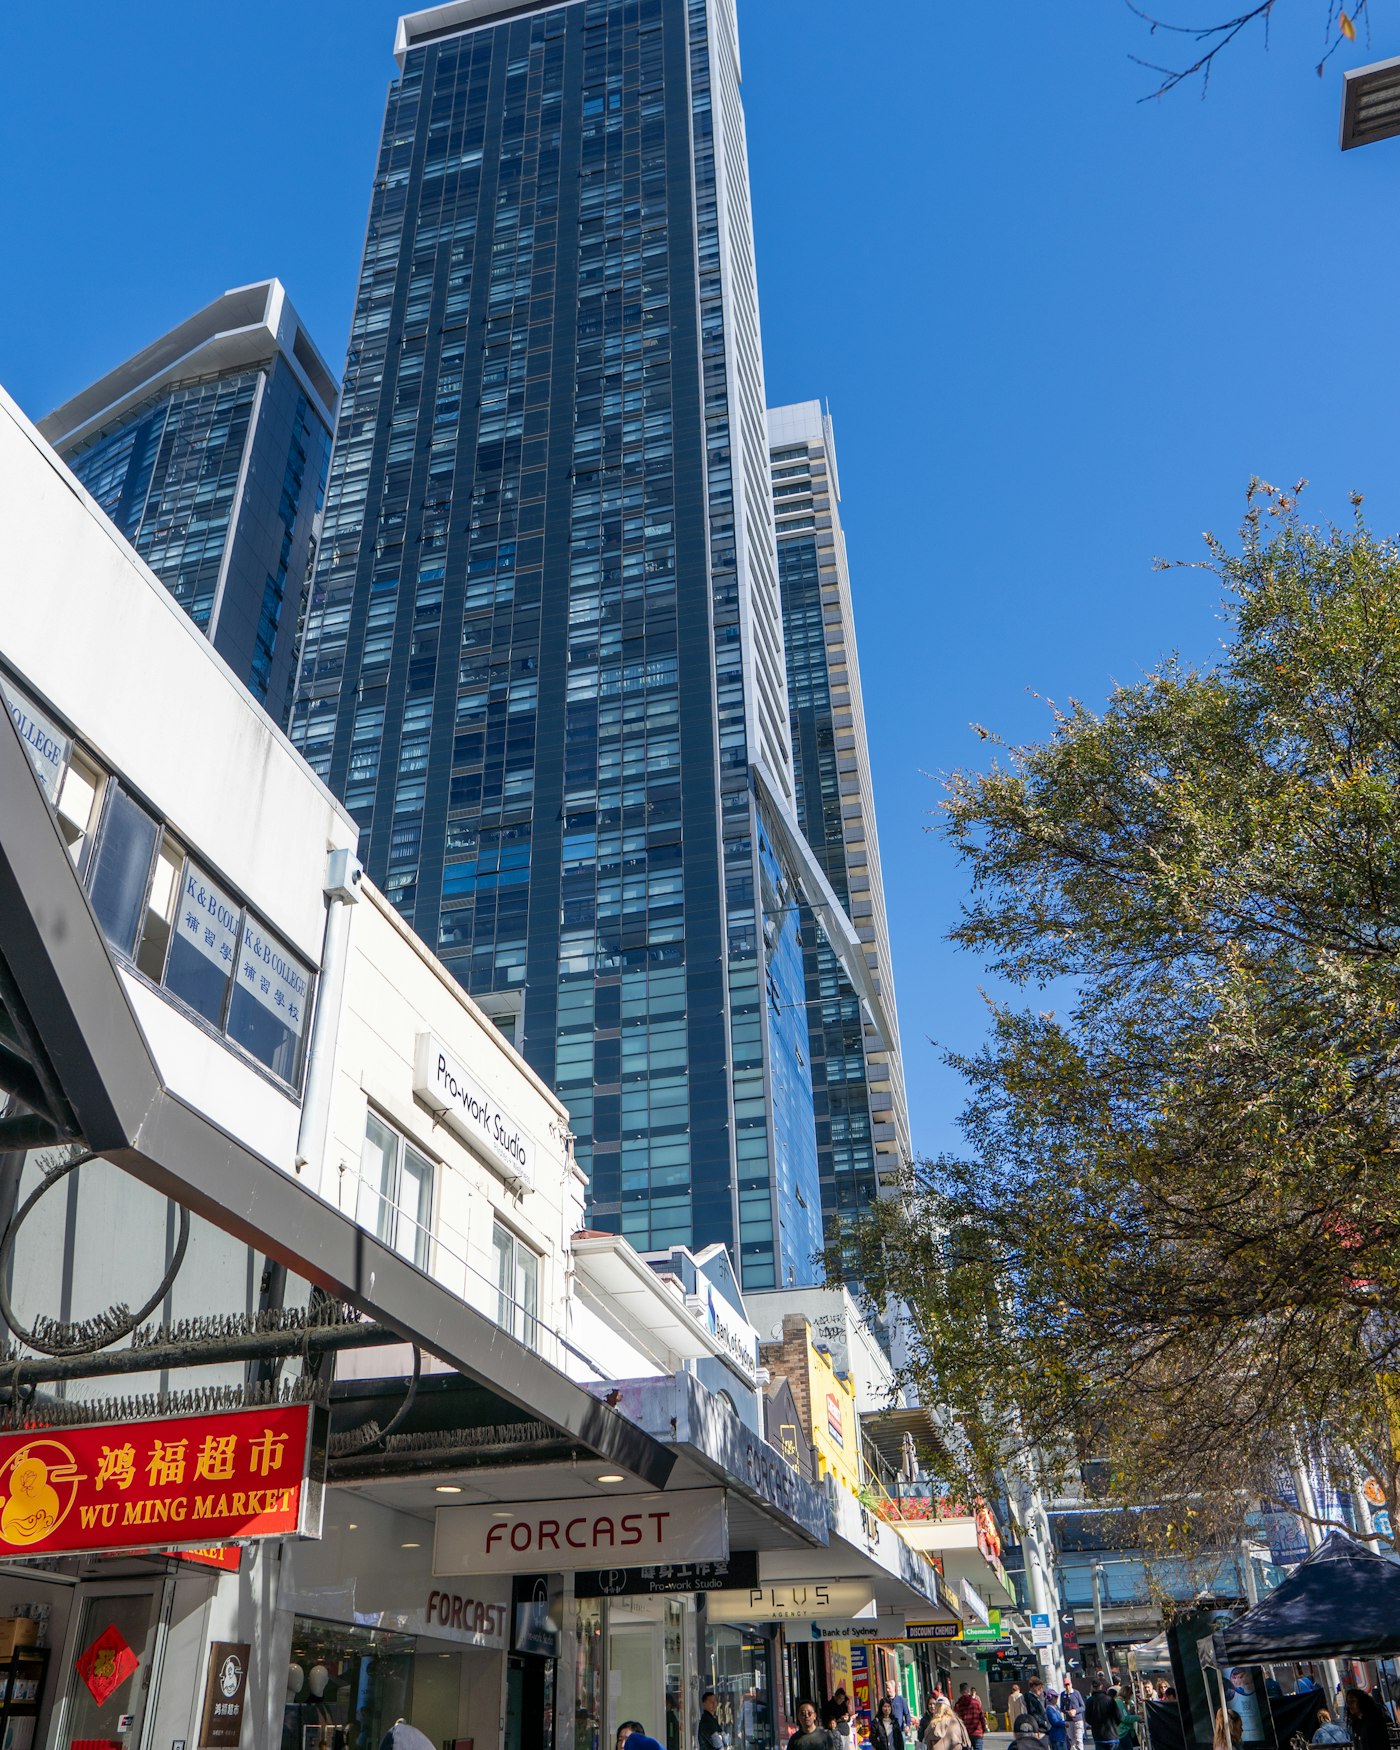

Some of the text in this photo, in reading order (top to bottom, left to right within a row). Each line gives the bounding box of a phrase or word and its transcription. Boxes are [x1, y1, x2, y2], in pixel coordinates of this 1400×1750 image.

[187, 876, 197, 899] K
[197, 887, 206, 909] &
[207, 894, 217, 916] B
[244, 927, 307, 998] K & B COLLEGE
[243, 961, 299, 1022] 補習學校
[437, 1053, 526, 1165] Pro-work Studio
[95, 1429, 289, 1491] 鸿福超市
[79, 1487, 295, 1530] WU MING MARKET
[485, 1512, 670, 1554] FORCAST
[649, 1578, 723, 1592] Pro-work Studio
[426, 1590, 507, 1638] FORCAST
[772, 1610, 808, 1618] AGENCY
[822, 1627, 879, 1638] Bank of Sydney
[909, 1625, 957, 1637] DISCOUNT CHEMIST
